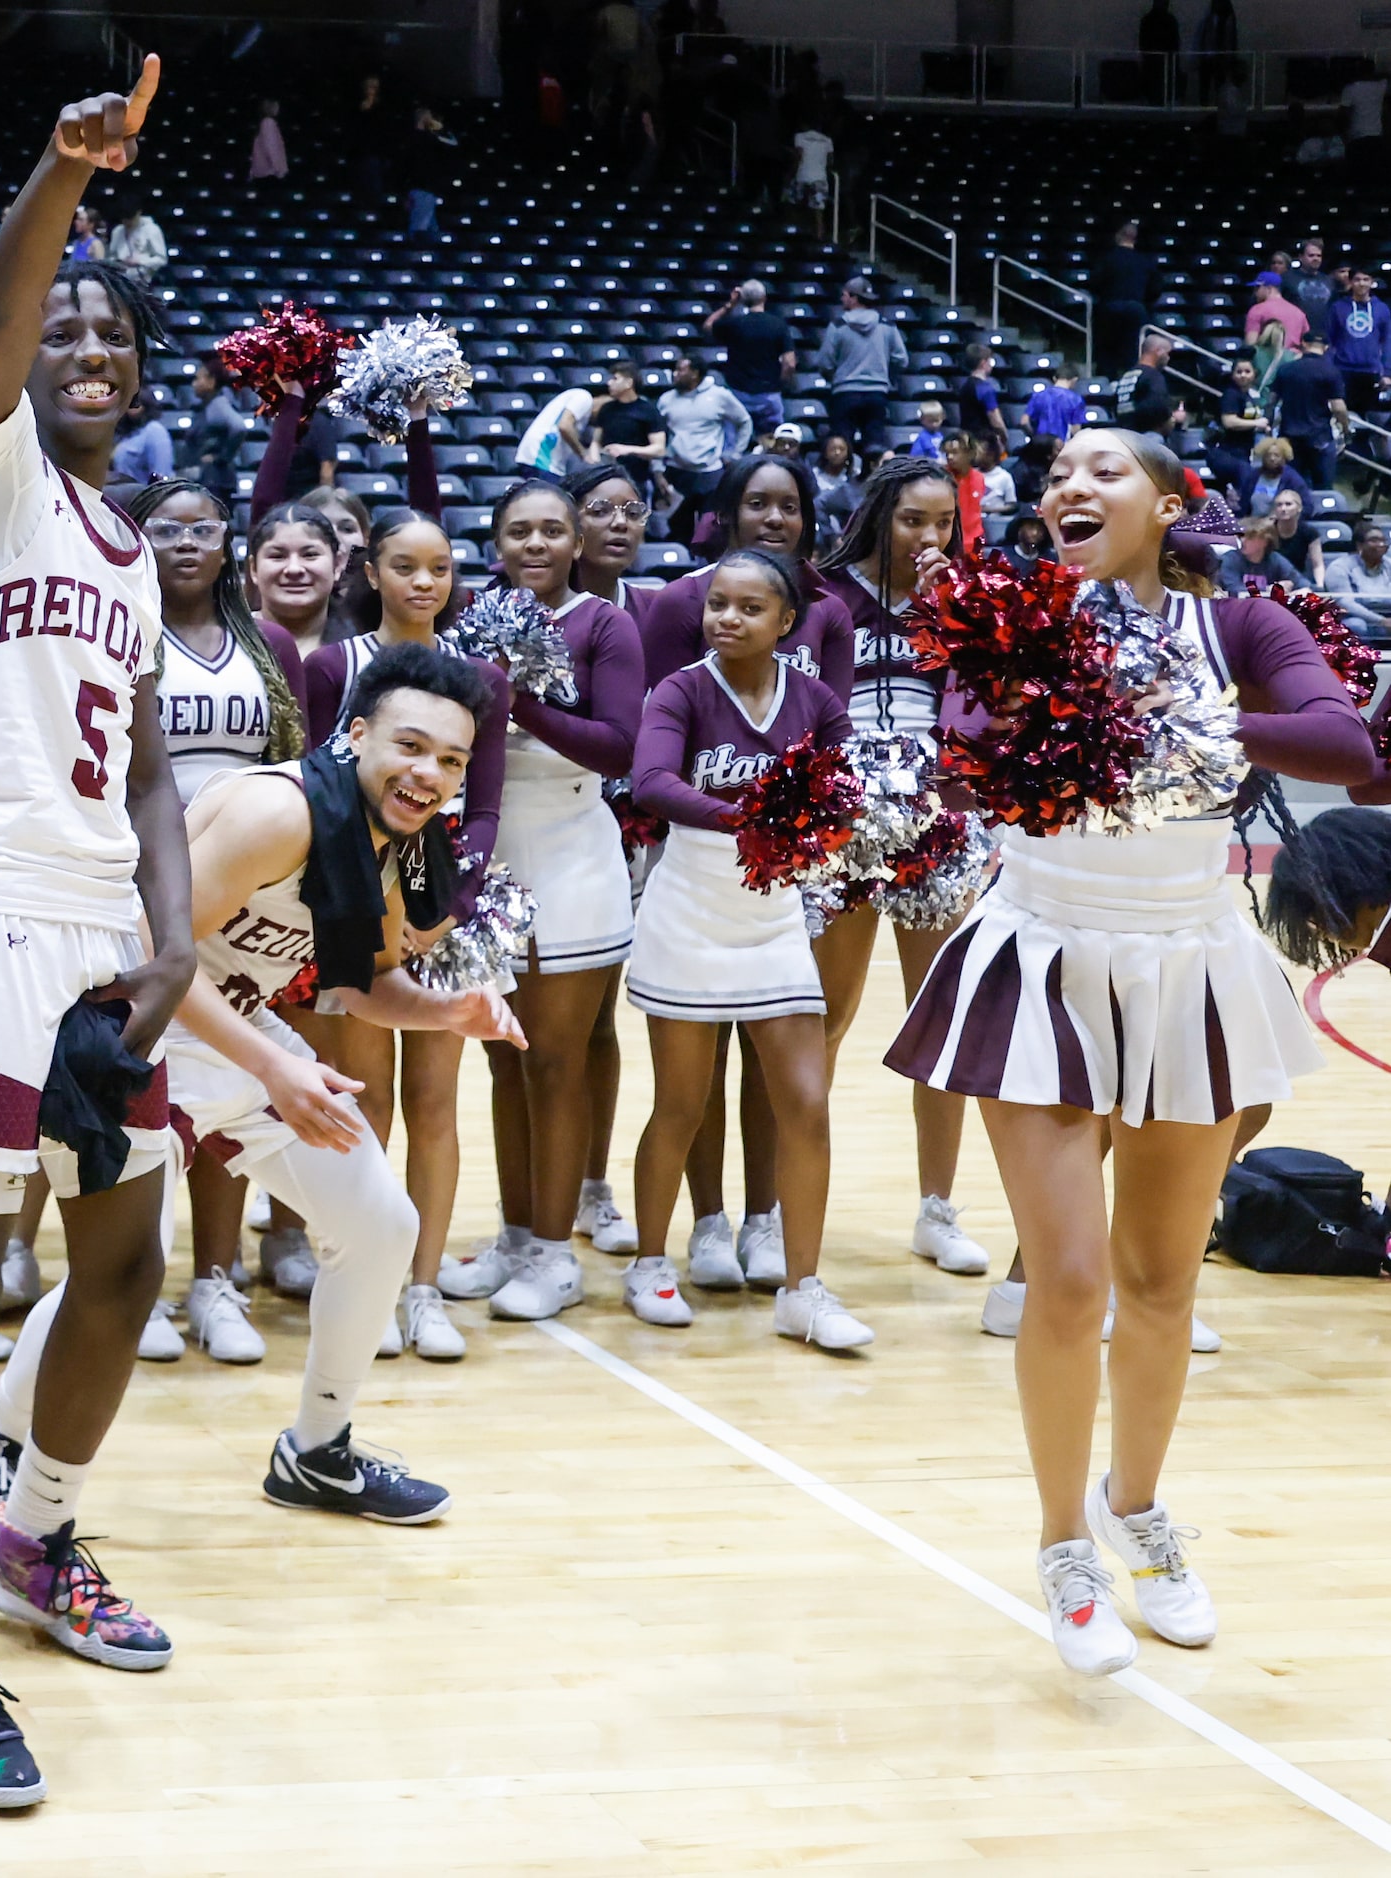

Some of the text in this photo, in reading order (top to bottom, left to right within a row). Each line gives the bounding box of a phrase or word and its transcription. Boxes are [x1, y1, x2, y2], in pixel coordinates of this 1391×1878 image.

[104, 598, 143, 684] OA
[70, 679, 119, 801] 5
[226, 694, 270, 737] OA
